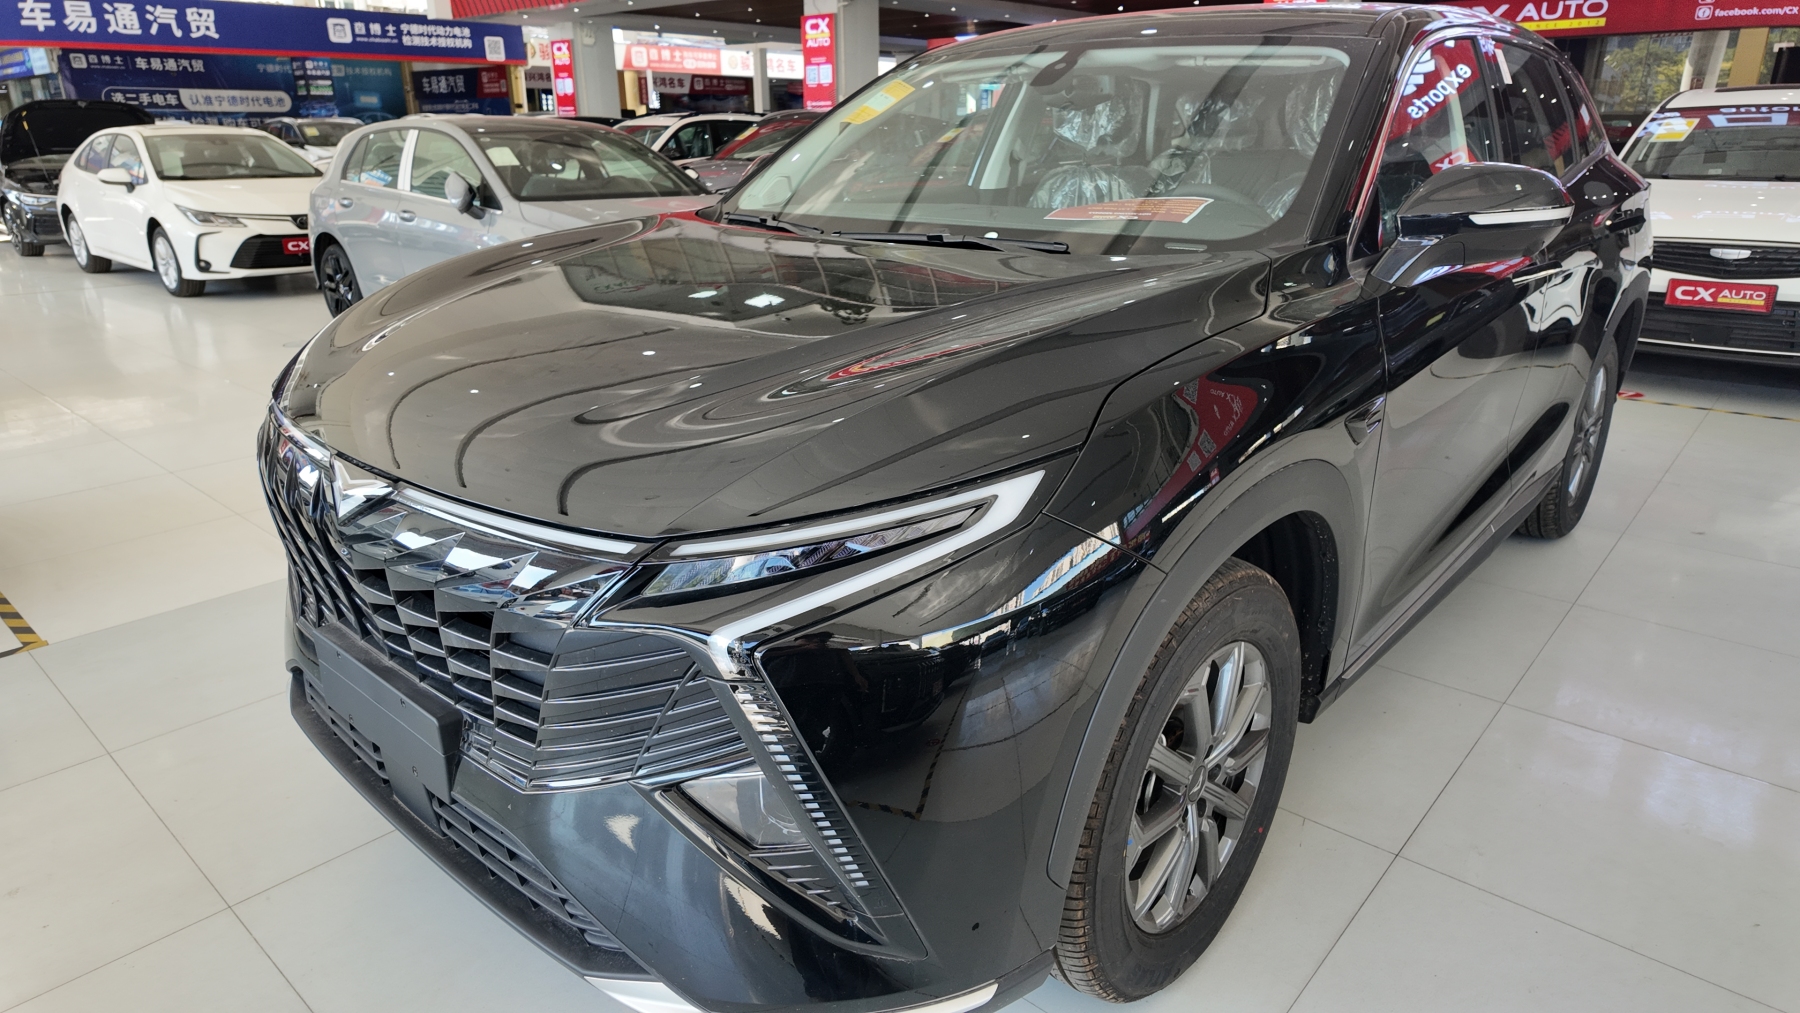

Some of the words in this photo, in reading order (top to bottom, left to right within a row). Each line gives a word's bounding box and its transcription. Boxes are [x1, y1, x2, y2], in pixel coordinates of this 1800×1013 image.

[1515, 0, 1609, 22] AUTO
[18, 0, 220, 39] 车易通汽贸
[805, 17, 830, 34] CX
[400, 23, 471, 37] 宁德时代动力电池
[402, 35, 473, 49] 检测技术授权机构
[806, 37, 831, 47] AUTO
[135, 57, 205, 72] 车易通汽贸
[422, 75, 466, 94] 车易通汽贸
[189, 94, 287, 107] 认准宁德时代电池
[287, 241, 309, 251] CX
[1675, 286, 1716, 302] CX
[1719, 289, 1767, 300] AUTO
